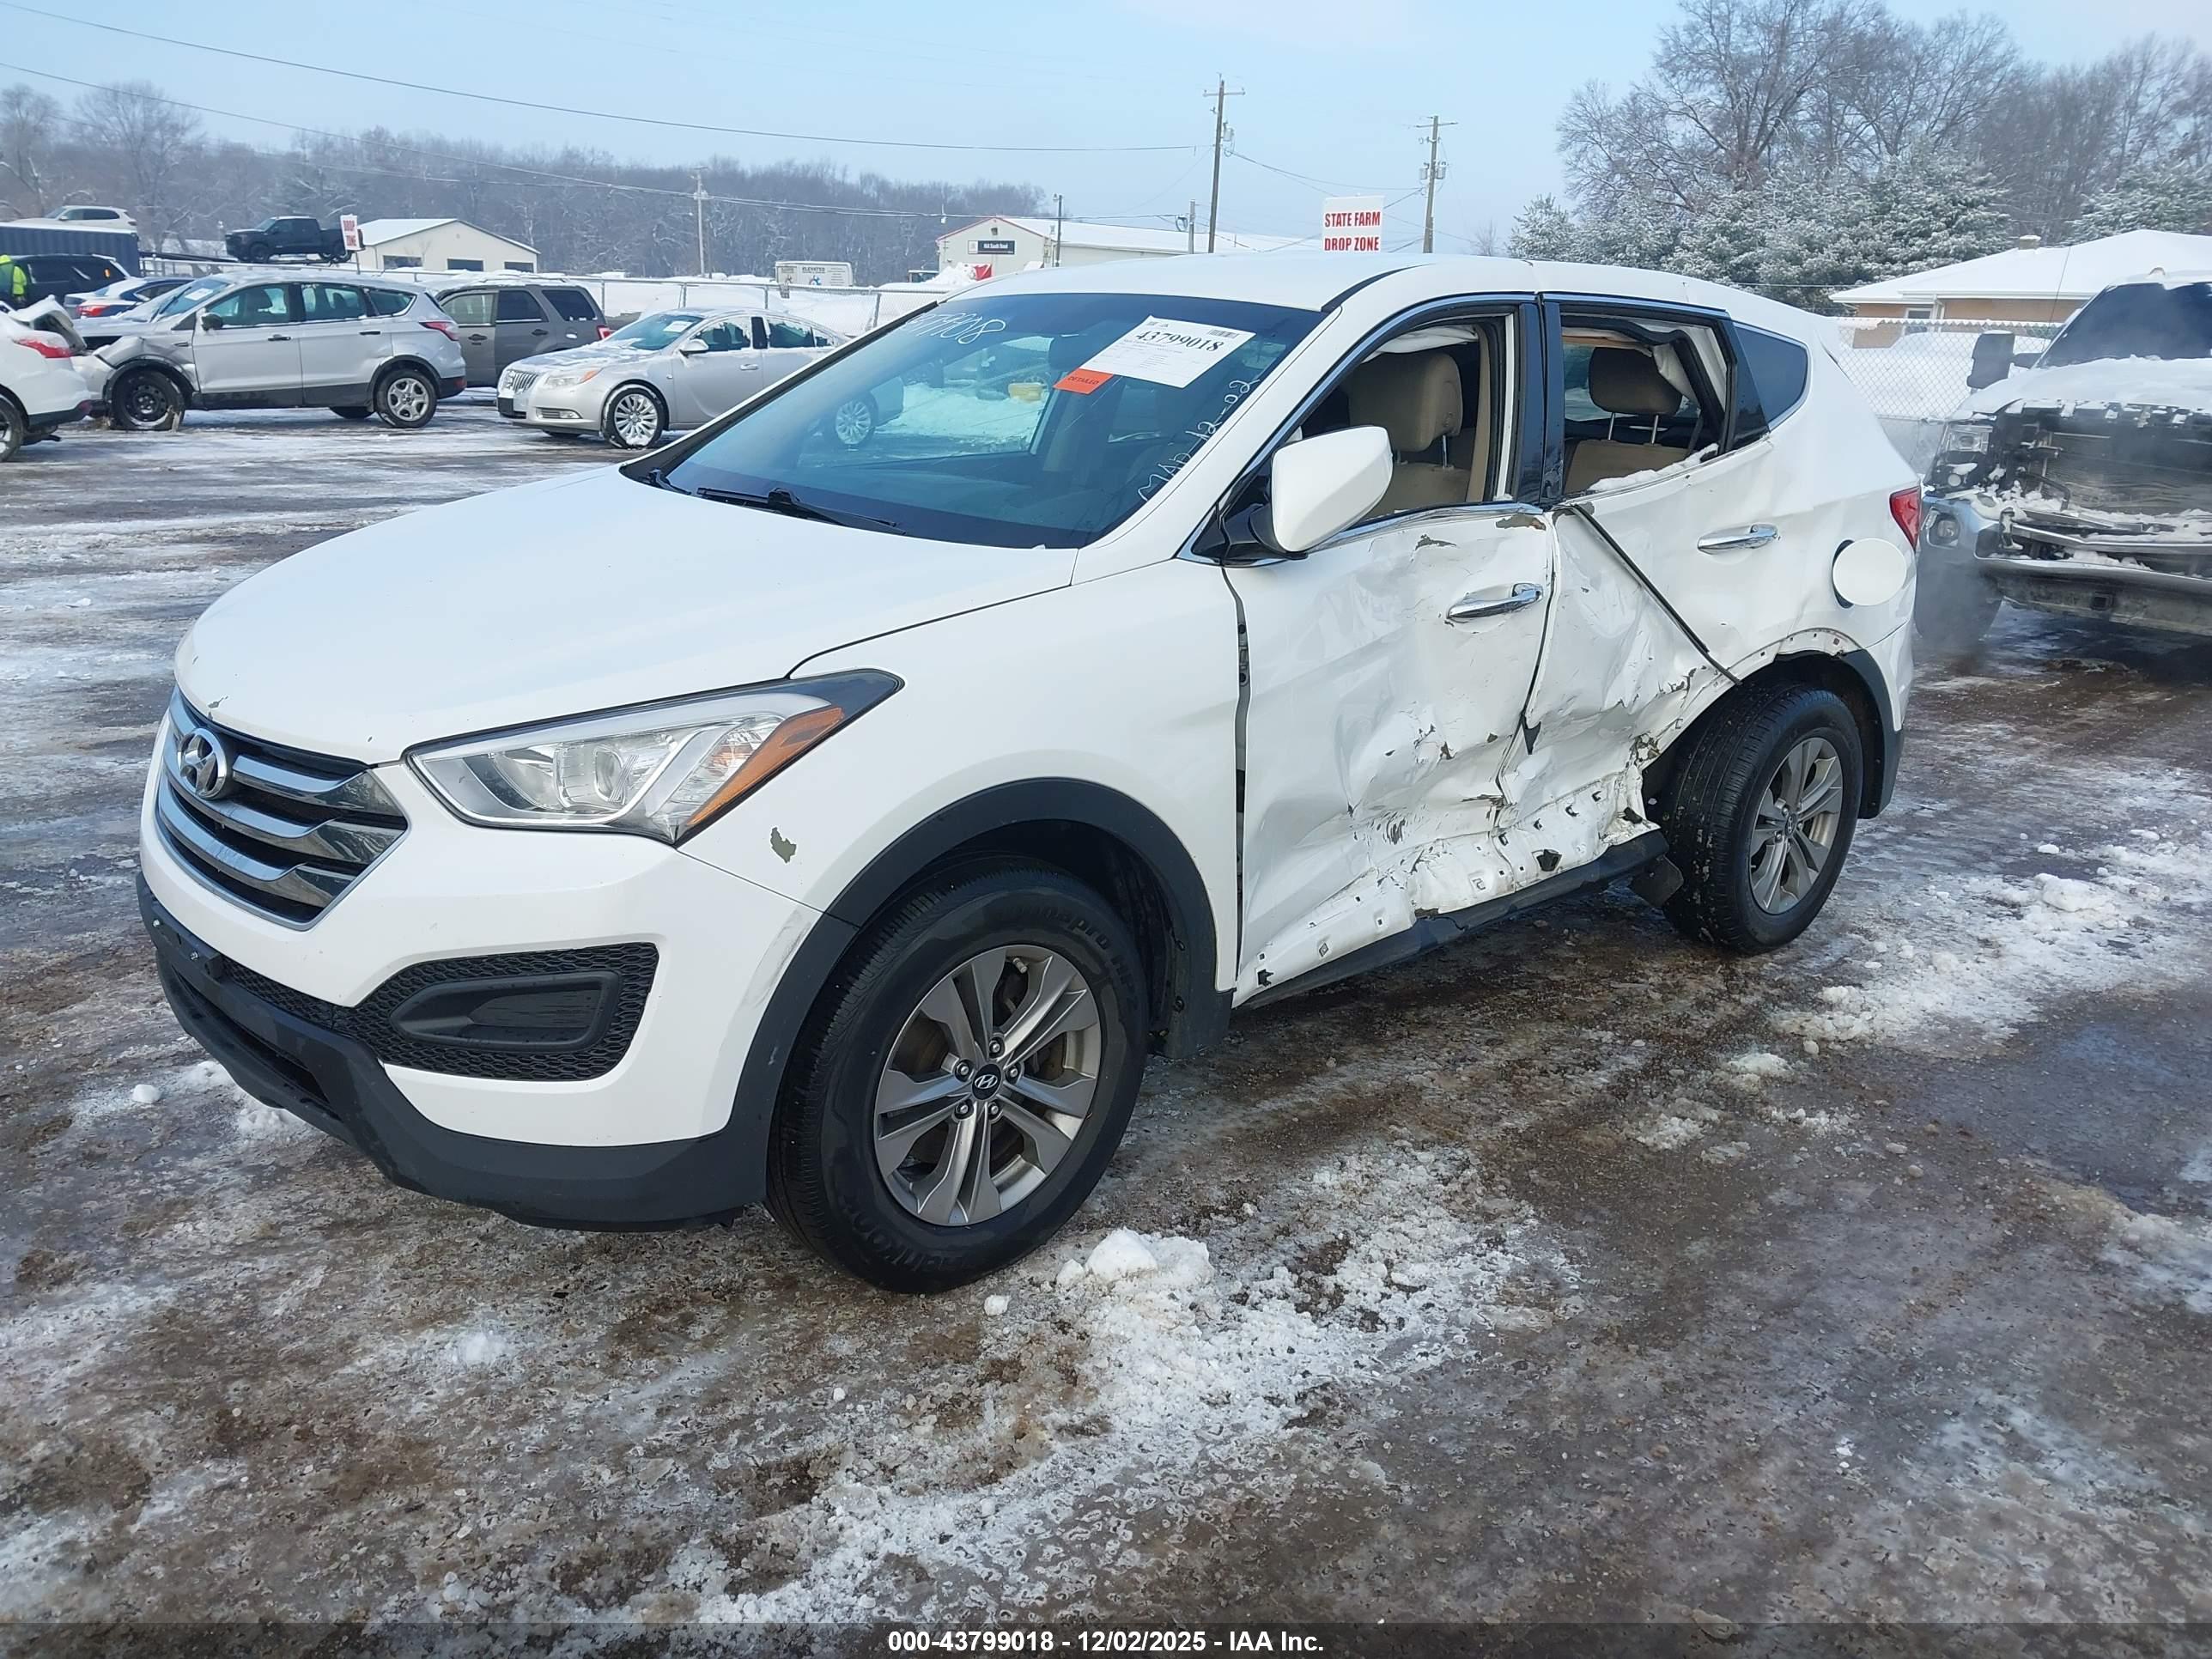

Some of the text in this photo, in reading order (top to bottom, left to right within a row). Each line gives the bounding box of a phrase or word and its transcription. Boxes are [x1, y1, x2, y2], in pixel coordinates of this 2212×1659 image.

[1324, 211, 1381, 228] STATE FARM
[1324, 236, 1380, 251] DROP ZONE
[1135, 330, 1224, 353] 43799018
[1067, 375, 1099, 385] DETAILED
